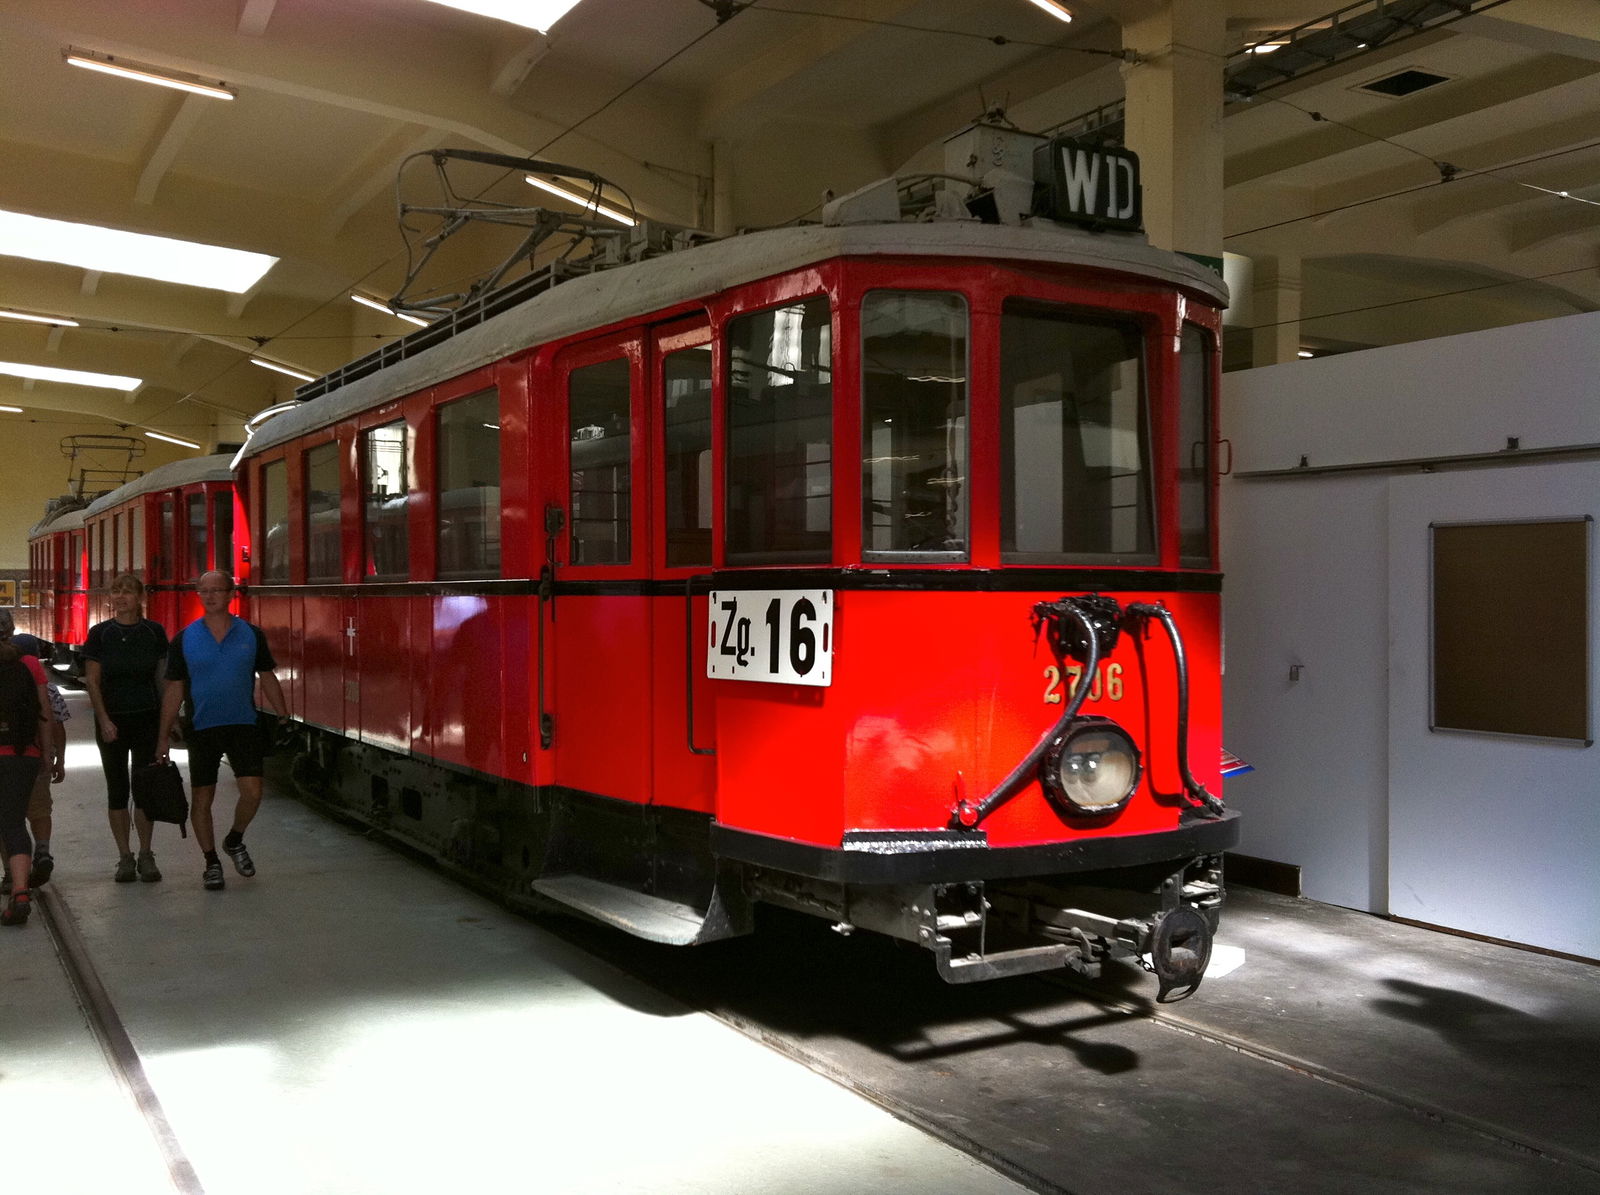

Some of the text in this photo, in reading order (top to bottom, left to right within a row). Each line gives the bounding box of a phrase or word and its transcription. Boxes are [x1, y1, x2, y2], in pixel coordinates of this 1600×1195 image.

[1062, 147, 1134, 219] WD
[721, 597, 816, 676] Zg. 16
